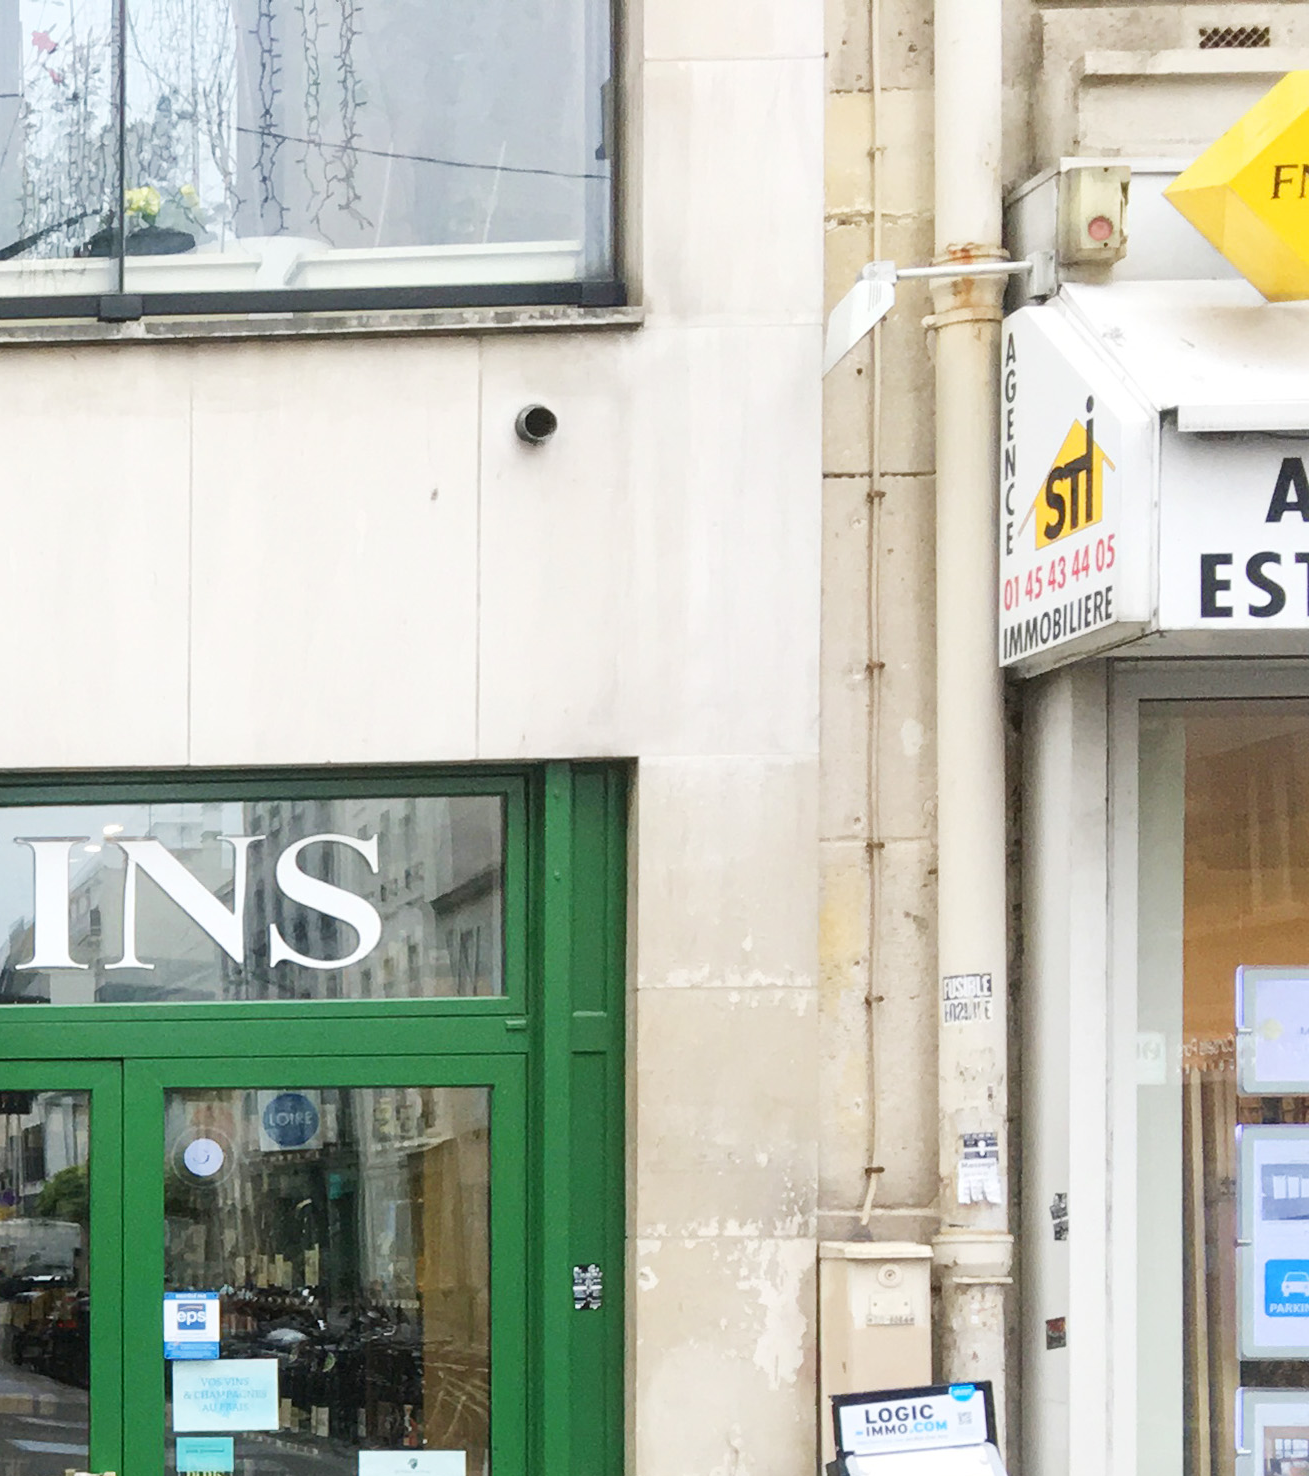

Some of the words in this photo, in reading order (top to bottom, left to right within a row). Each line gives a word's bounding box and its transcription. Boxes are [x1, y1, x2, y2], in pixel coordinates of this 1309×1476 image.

[1004, 332, 1017, 557] AGENCE
[1003, 576, 1020, 612] 01
[1024, 565, 1044, 604] 45
[1047, 556, 1067, 593] 43
[1071, 545, 1091, 582] 44
[1095, 533, 1117, 573] 05
[1002, 584, 1115, 661] IMMOBILIERE
[268, 1110, 313, 1127] LOIRE
[177, 1310, 207, 1326] eps
[865, 1404, 934, 1424] LOGIC
